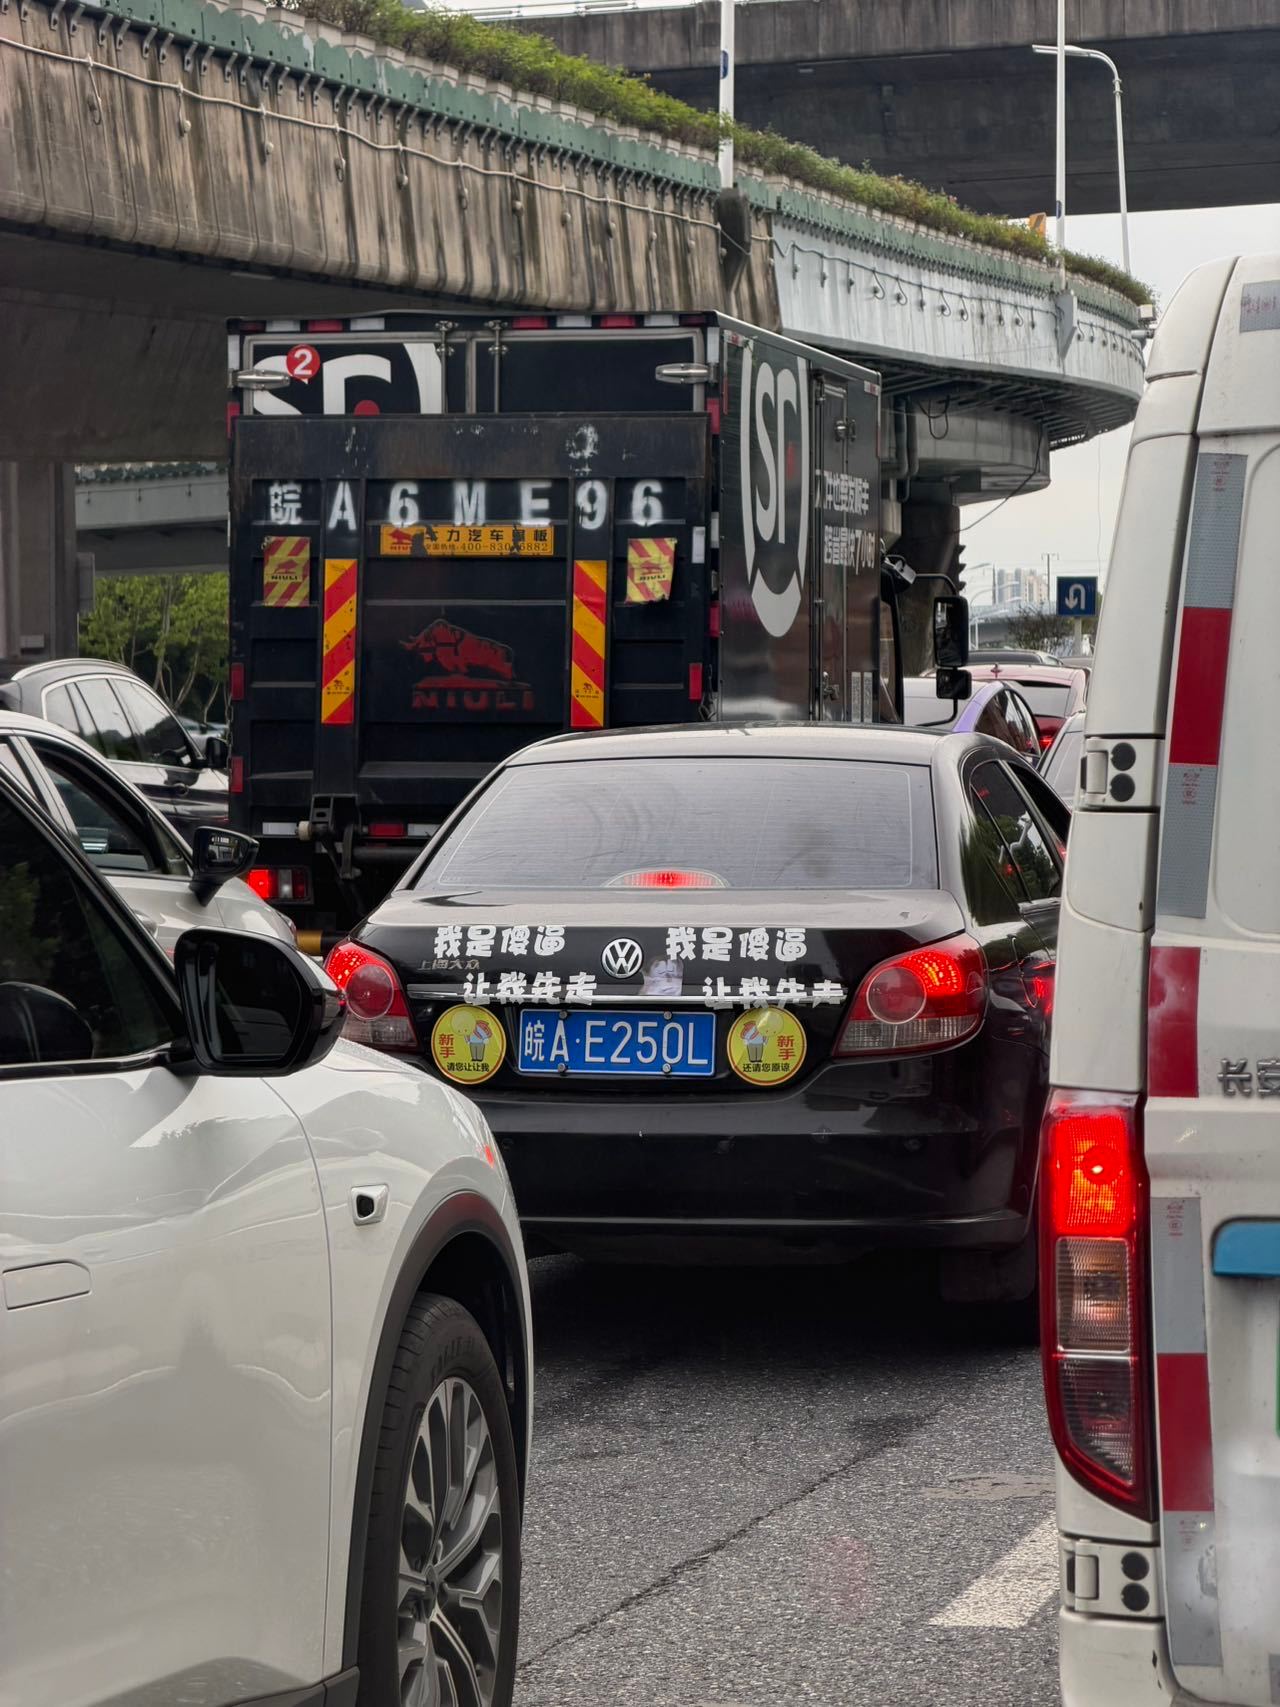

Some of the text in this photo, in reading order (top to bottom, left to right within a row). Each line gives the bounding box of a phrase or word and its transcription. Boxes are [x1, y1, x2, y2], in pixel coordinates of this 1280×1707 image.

[293, 349, 312, 375] 2
[411, 691, 535, 710] NIULI
[434, 925, 566, 958] 我是傻逼
[666, 926, 808, 962] 我是傻逼
[463, 971, 598, 1006] 让我先走
[702, 976, 848, 1011] 让我先走
[439, 1033, 456, 1058] 新手
[777, 1035, 796, 1060] 新手
[446, 1062, 490, 1072] 请您让让我
[742, 1063, 791, 1073] 还请您原谅
